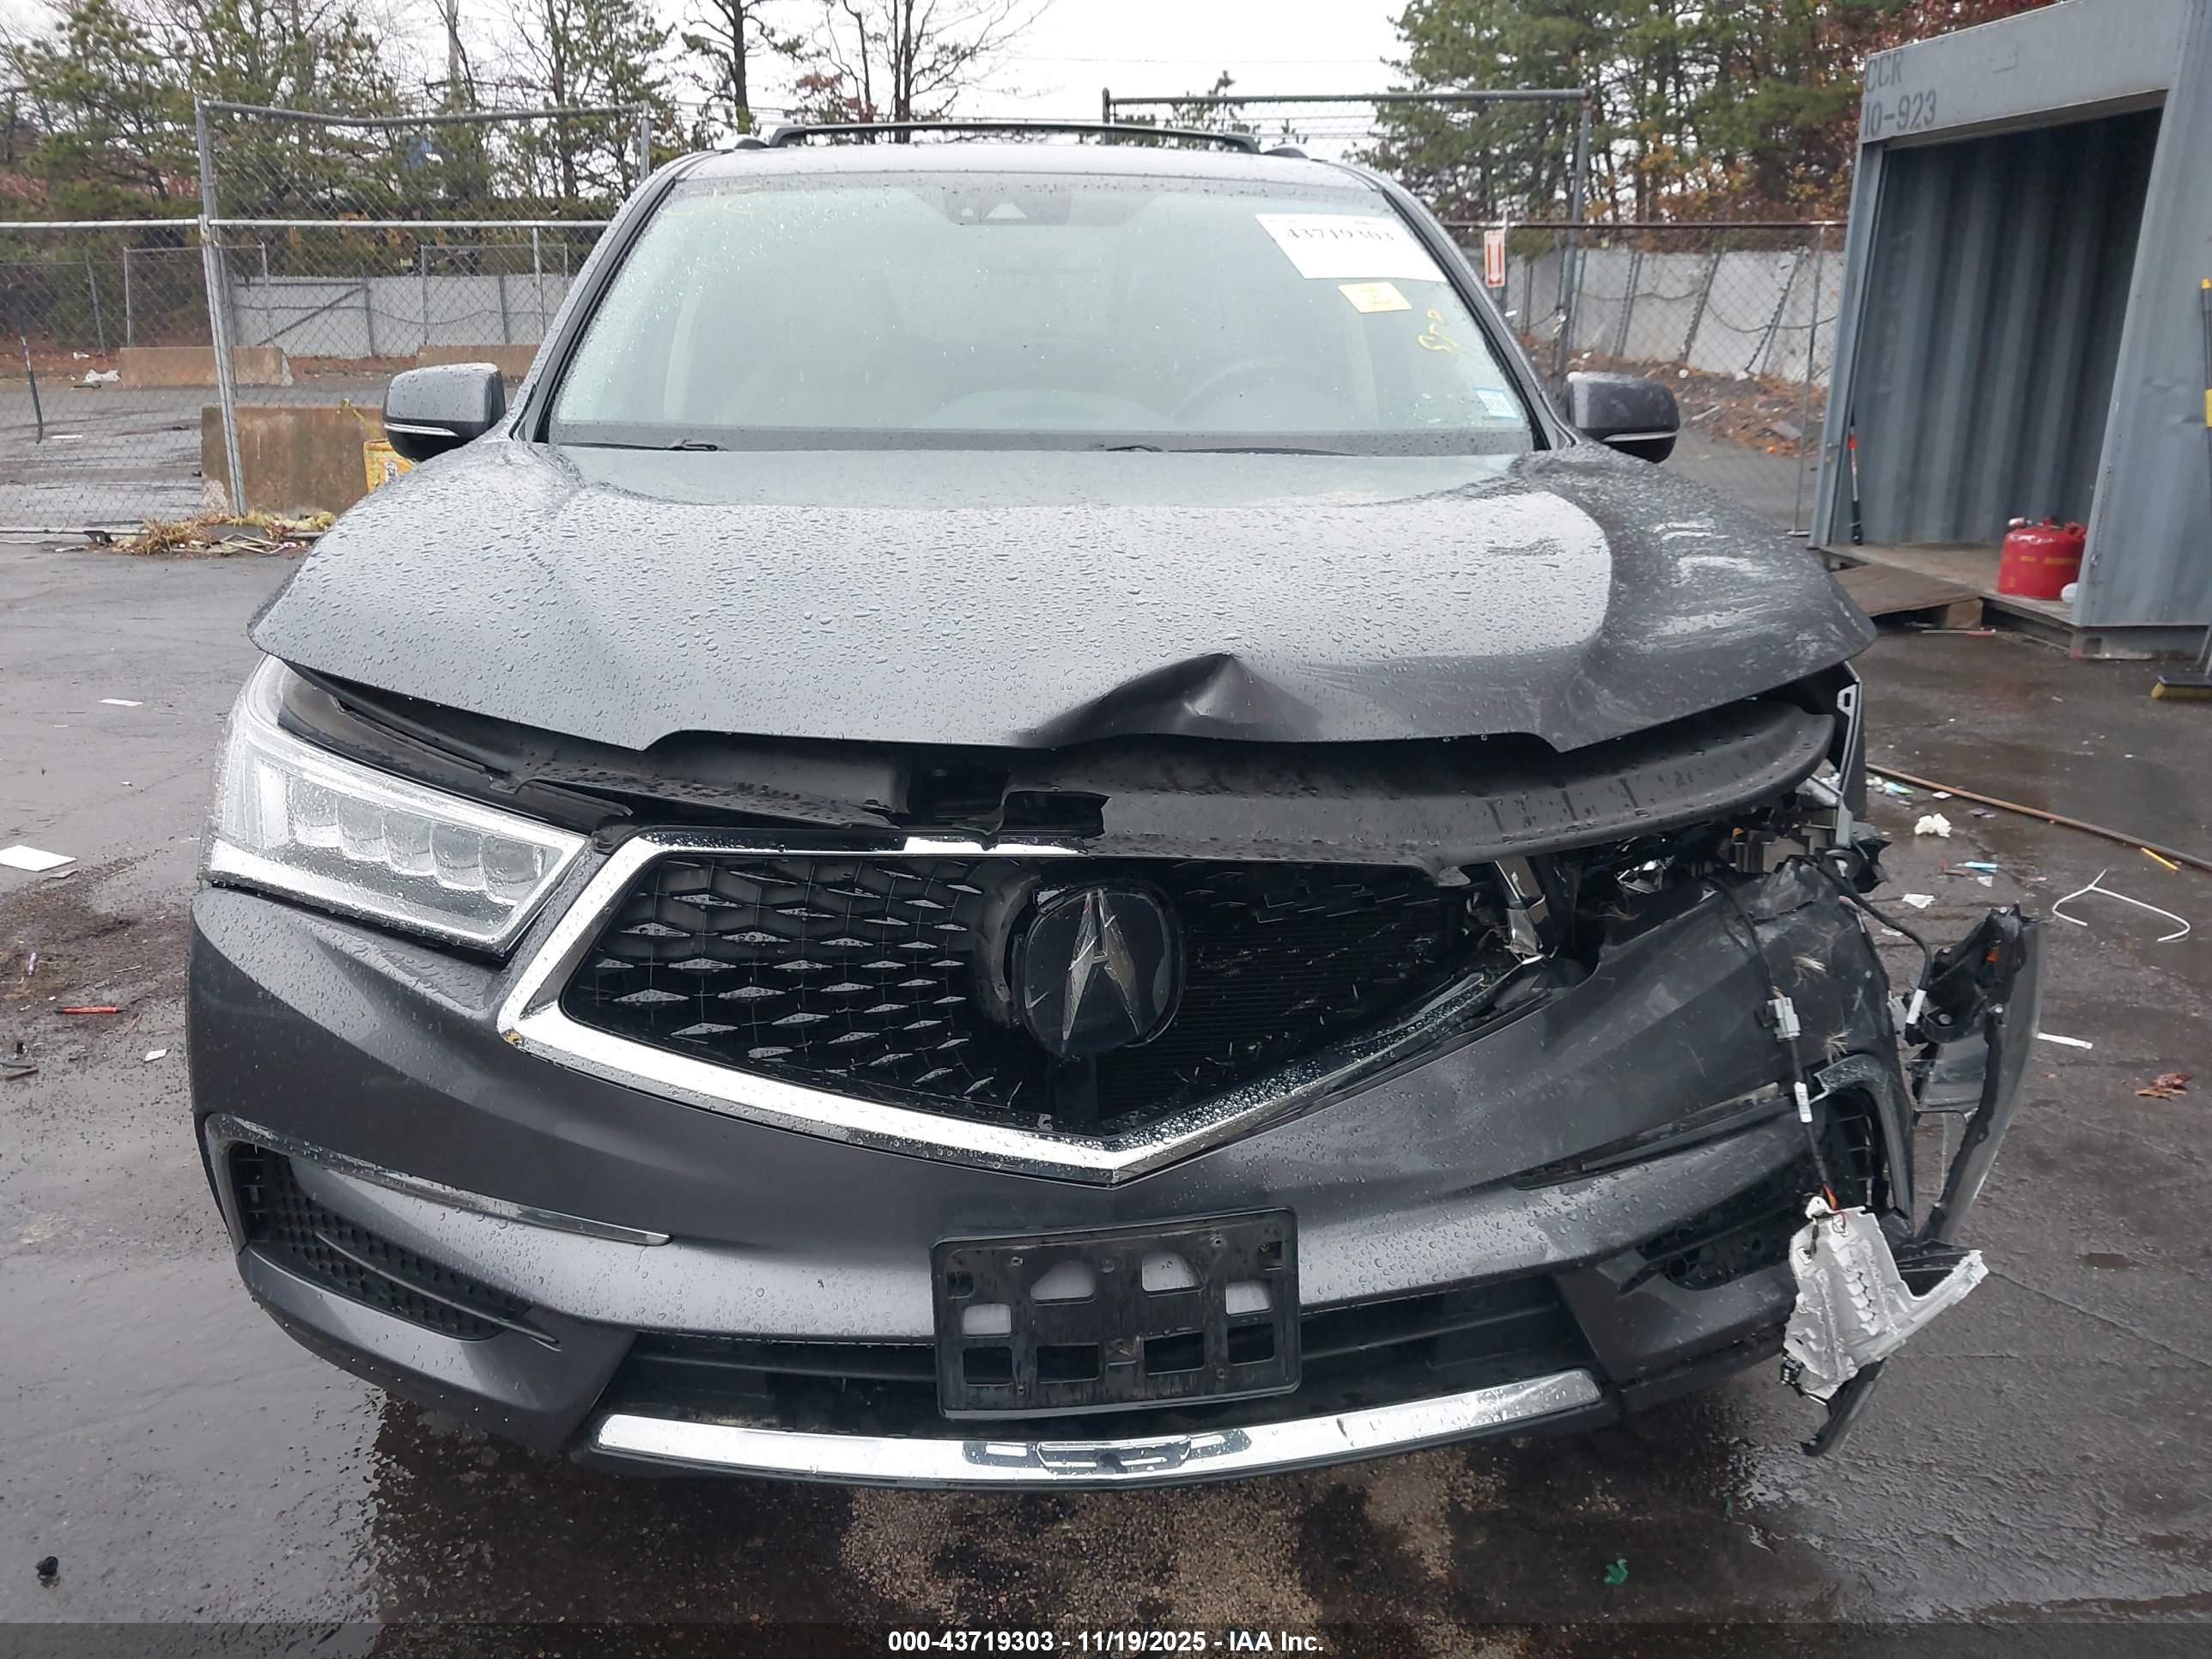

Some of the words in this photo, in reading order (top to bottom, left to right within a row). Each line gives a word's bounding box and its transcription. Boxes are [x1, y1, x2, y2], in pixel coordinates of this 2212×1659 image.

[1865, 52, 1904, 94] CCR
[1863, 89, 1937, 137] 10-923
[1286, 228, 1395, 241] 43719303
